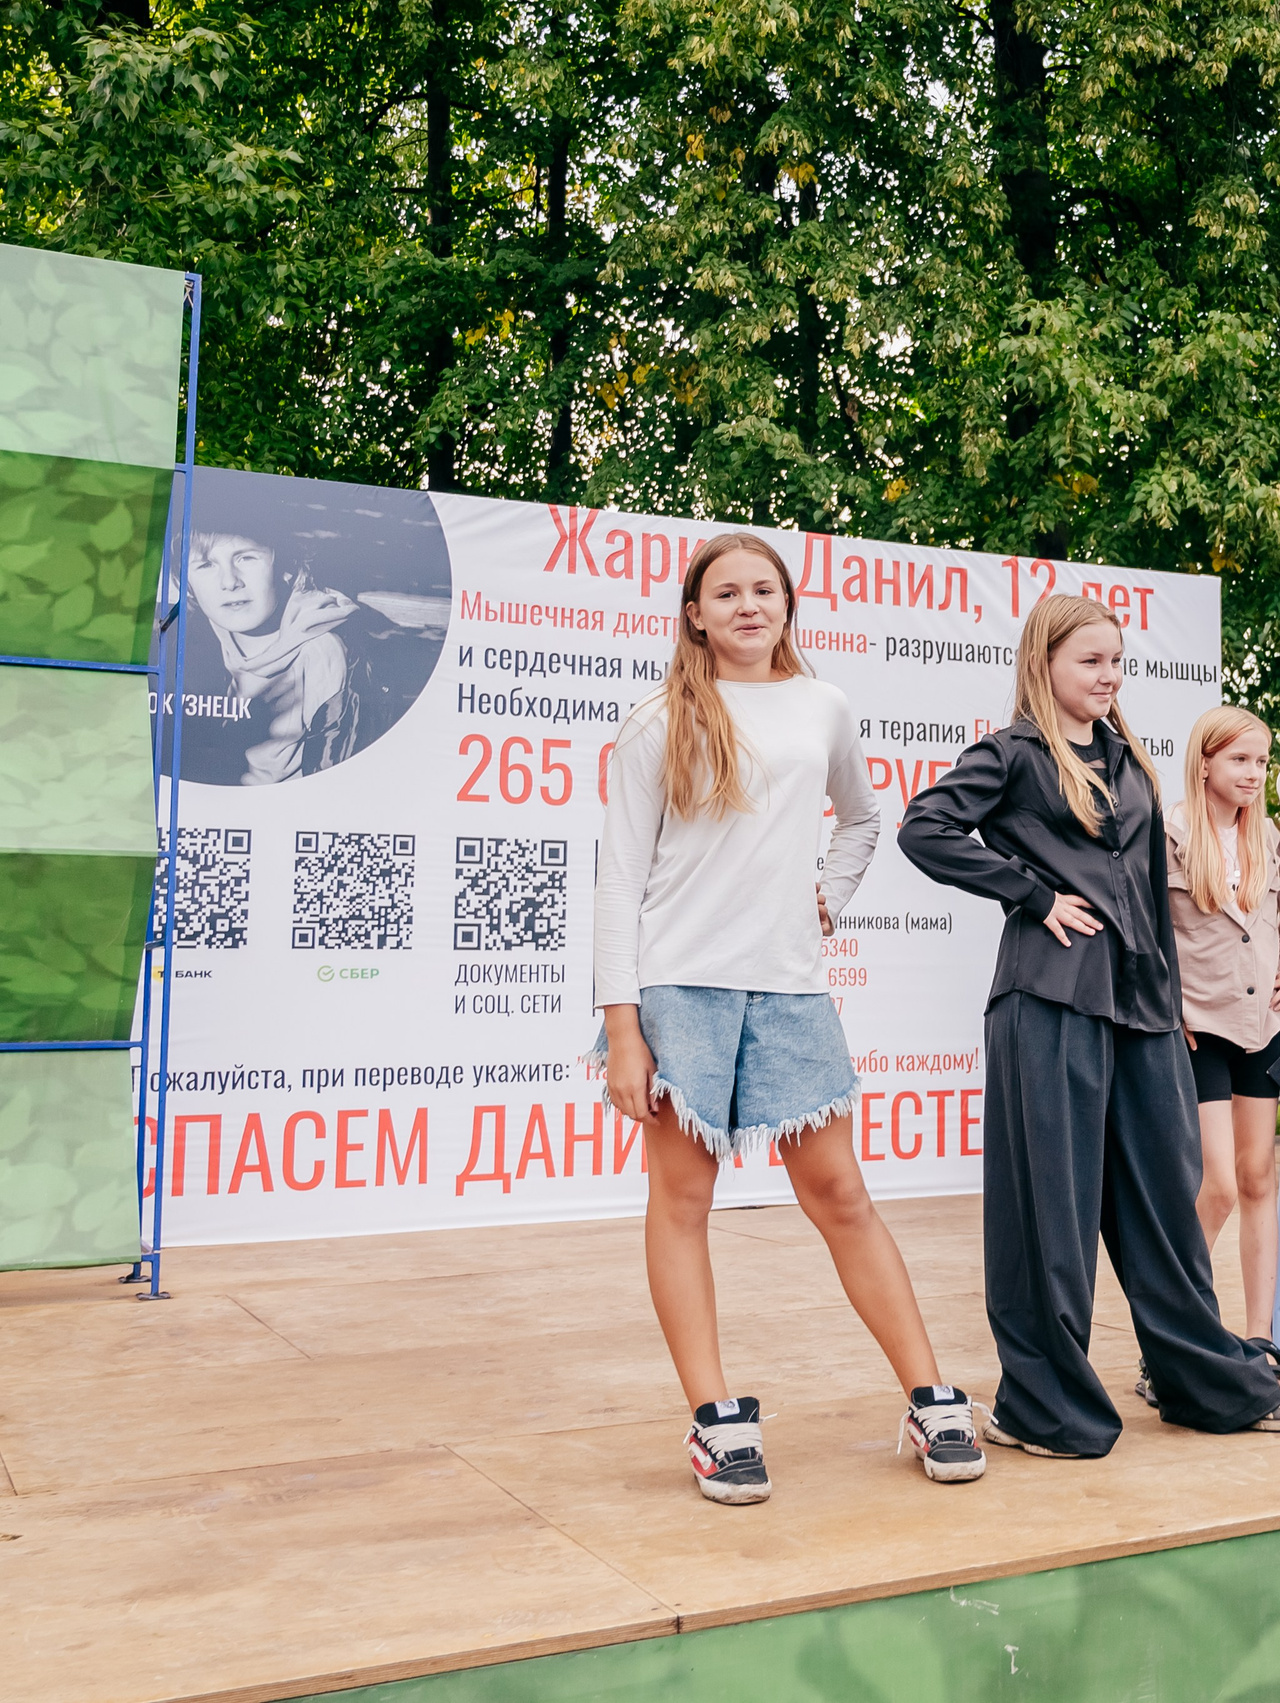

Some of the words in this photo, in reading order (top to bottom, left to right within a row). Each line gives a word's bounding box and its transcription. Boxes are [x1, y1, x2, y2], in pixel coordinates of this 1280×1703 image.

[543, 504, 707, 597] Жарк
[796, 532, 983, 624] Данил,
[460, 590, 604, 633] Мышечная
[796, 628, 877, 654] шенна-
[886, 636, 1018, 671] разрушаютс
[1146, 659, 1218, 686] мышцы
[458, 647, 474, 668] и
[484, 647, 622, 679] сердечная
[148, 692, 252, 722] ОКЗНЕЦК
[457, 683, 619, 725] Необходима
[879, 719, 966, 747] терапия
[456, 734, 574, 806] 265
[835, 915, 900, 931] нникова
[905, 912, 953, 935] (мама)
[175, 970, 212, 978] БАНК
[339, 968, 380, 980] СБЕР
[454, 964, 566, 985] ДОКУМЕНТЫ
[828, 967, 867, 987] 6599
[454, 995, 466, 1014] И
[472, 996, 515, 1017] СОЦ.
[520, 994, 562, 1014] СЕТИ
[301, 1065, 345, 1093] при
[354, 1061, 464, 1091] переводе
[472, 1061, 571, 1088] укажите:
[895, 1049, 980, 1076] каждому!
[455, 1102, 650, 1197] ДАНИ
[861, 1088, 983, 1162] ЕСТЕ
